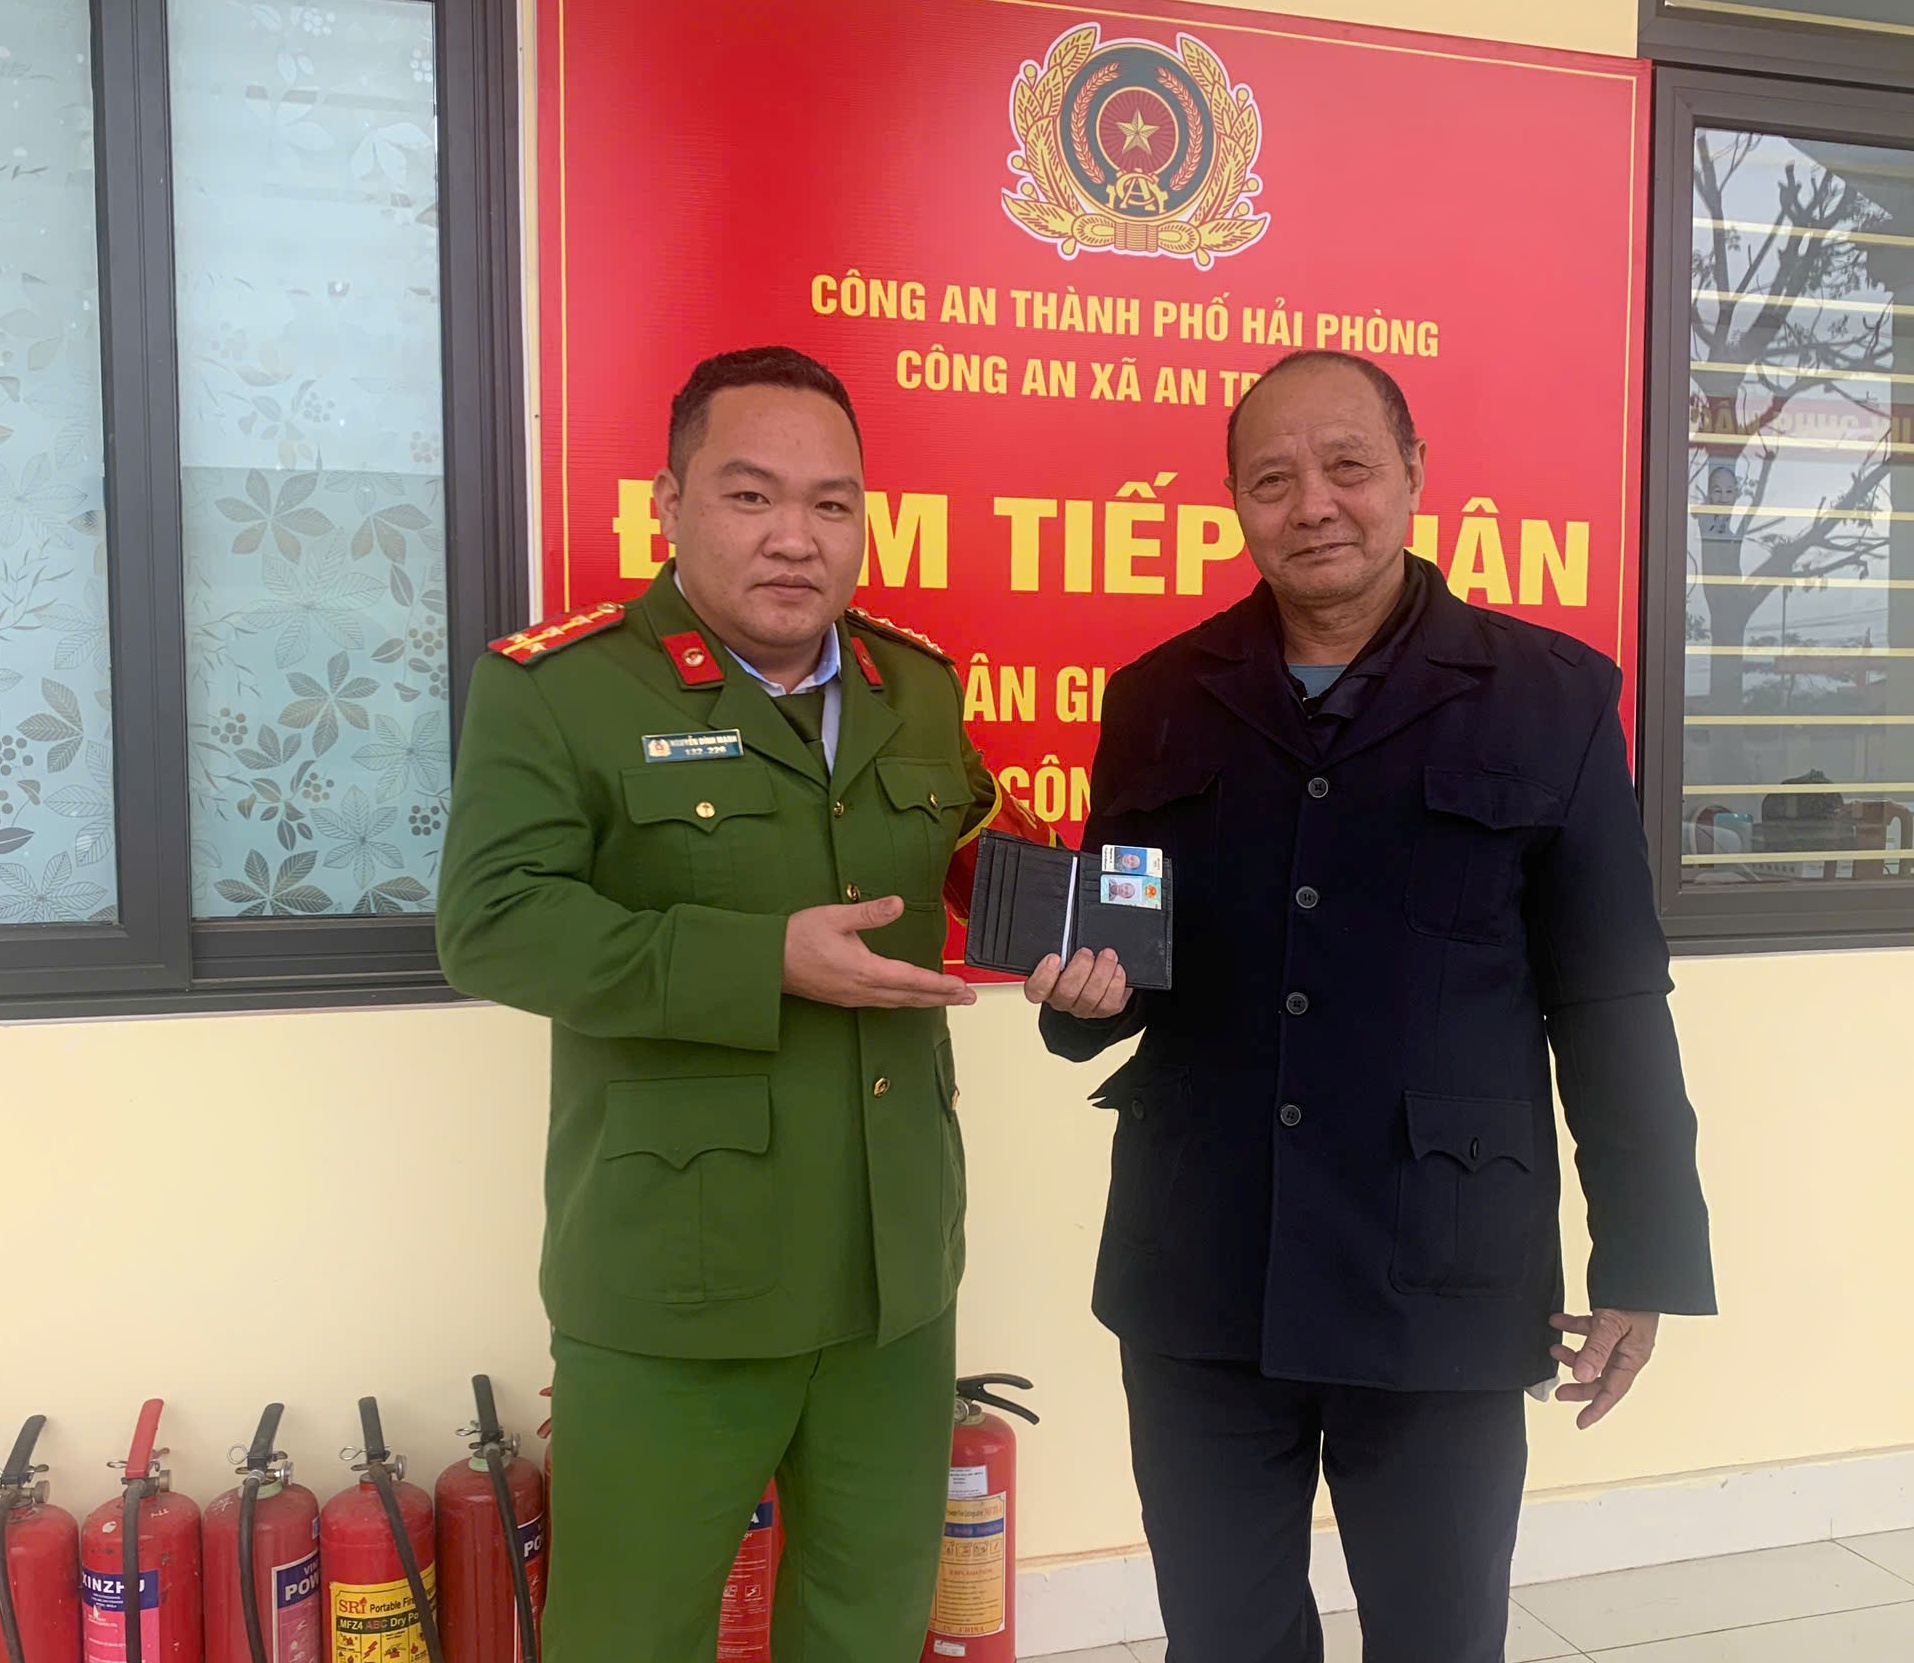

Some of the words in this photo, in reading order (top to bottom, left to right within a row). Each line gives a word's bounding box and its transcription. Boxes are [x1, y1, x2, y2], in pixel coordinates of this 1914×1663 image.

[811, 268, 926, 321] CÔNG
[939, 284, 997, 326] AN
[1010, 286, 1140, 335] THÀNH
[1153, 292, 1231, 342] PHỐ
[1242, 297, 1303, 347] HẢI
[1316, 308, 1439, 357] PHÒNG
[896, 343, 1008, 394] CÔNG
[1021, 358, 1077, 398] AN
[1089, 356, 1141, 402] XÃ
[1153, 366, 1207, 406] AN
[993, 471, 1246, 596] TIẾP
[963, 652, 1037, 723] ÂN
[1056, 665, 1106, 723] GI
[998, 754, 1091, 823] CÔN
[365, 1619, 388, 1630] ABC
[390, 1615, 407, 1628] Dry
[408, 1611, 419, 1624] Po
[369, 1600, 401, 1614] Portable
